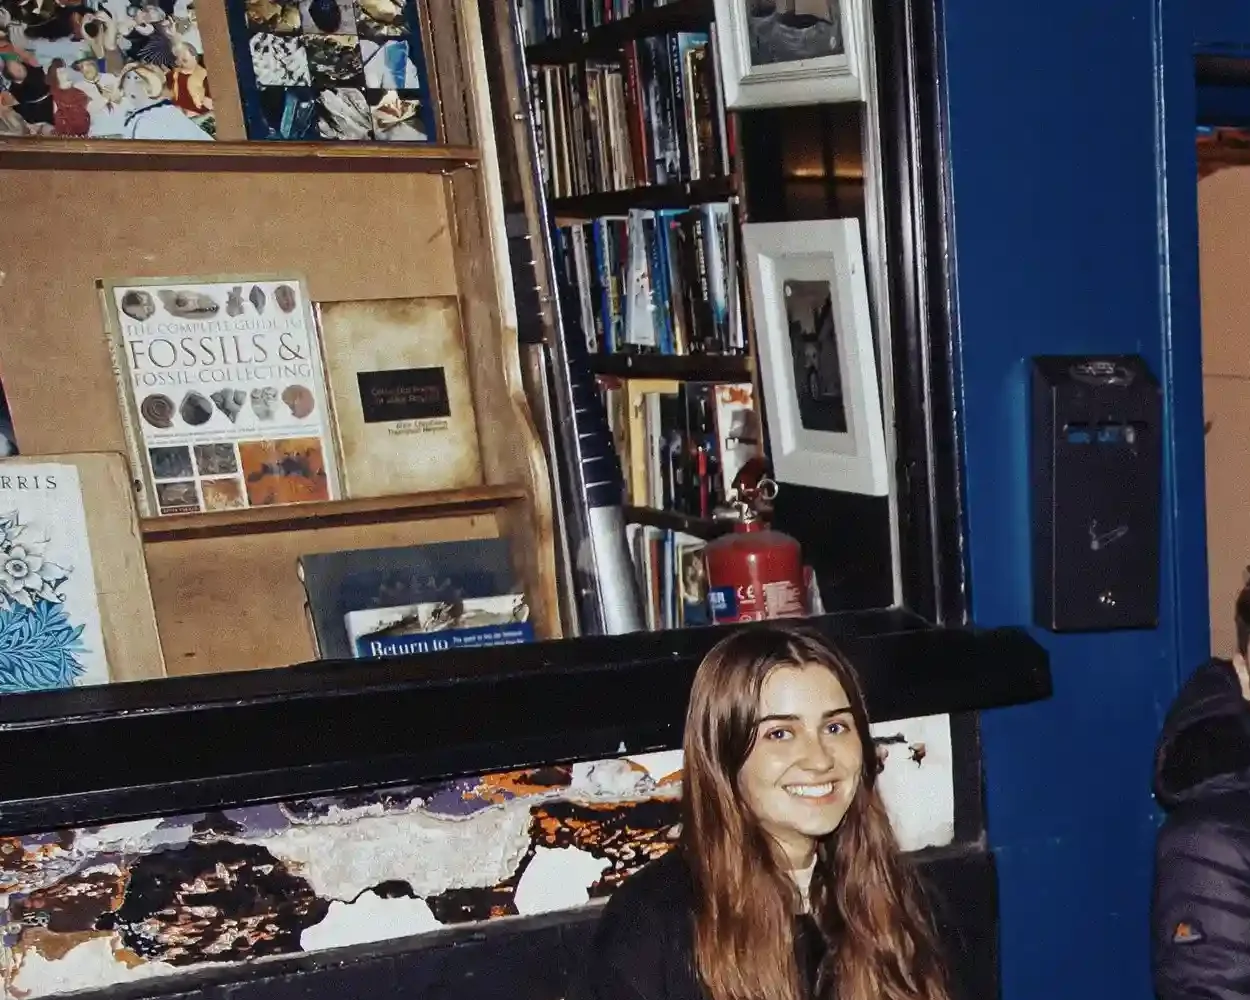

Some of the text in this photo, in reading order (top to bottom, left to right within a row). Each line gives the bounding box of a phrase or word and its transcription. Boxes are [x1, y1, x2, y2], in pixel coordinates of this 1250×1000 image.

[128, 332, 307, 370] FOSSILS &
[370, 640, 429, 658] Return
[432, 638, 449, 652] to
